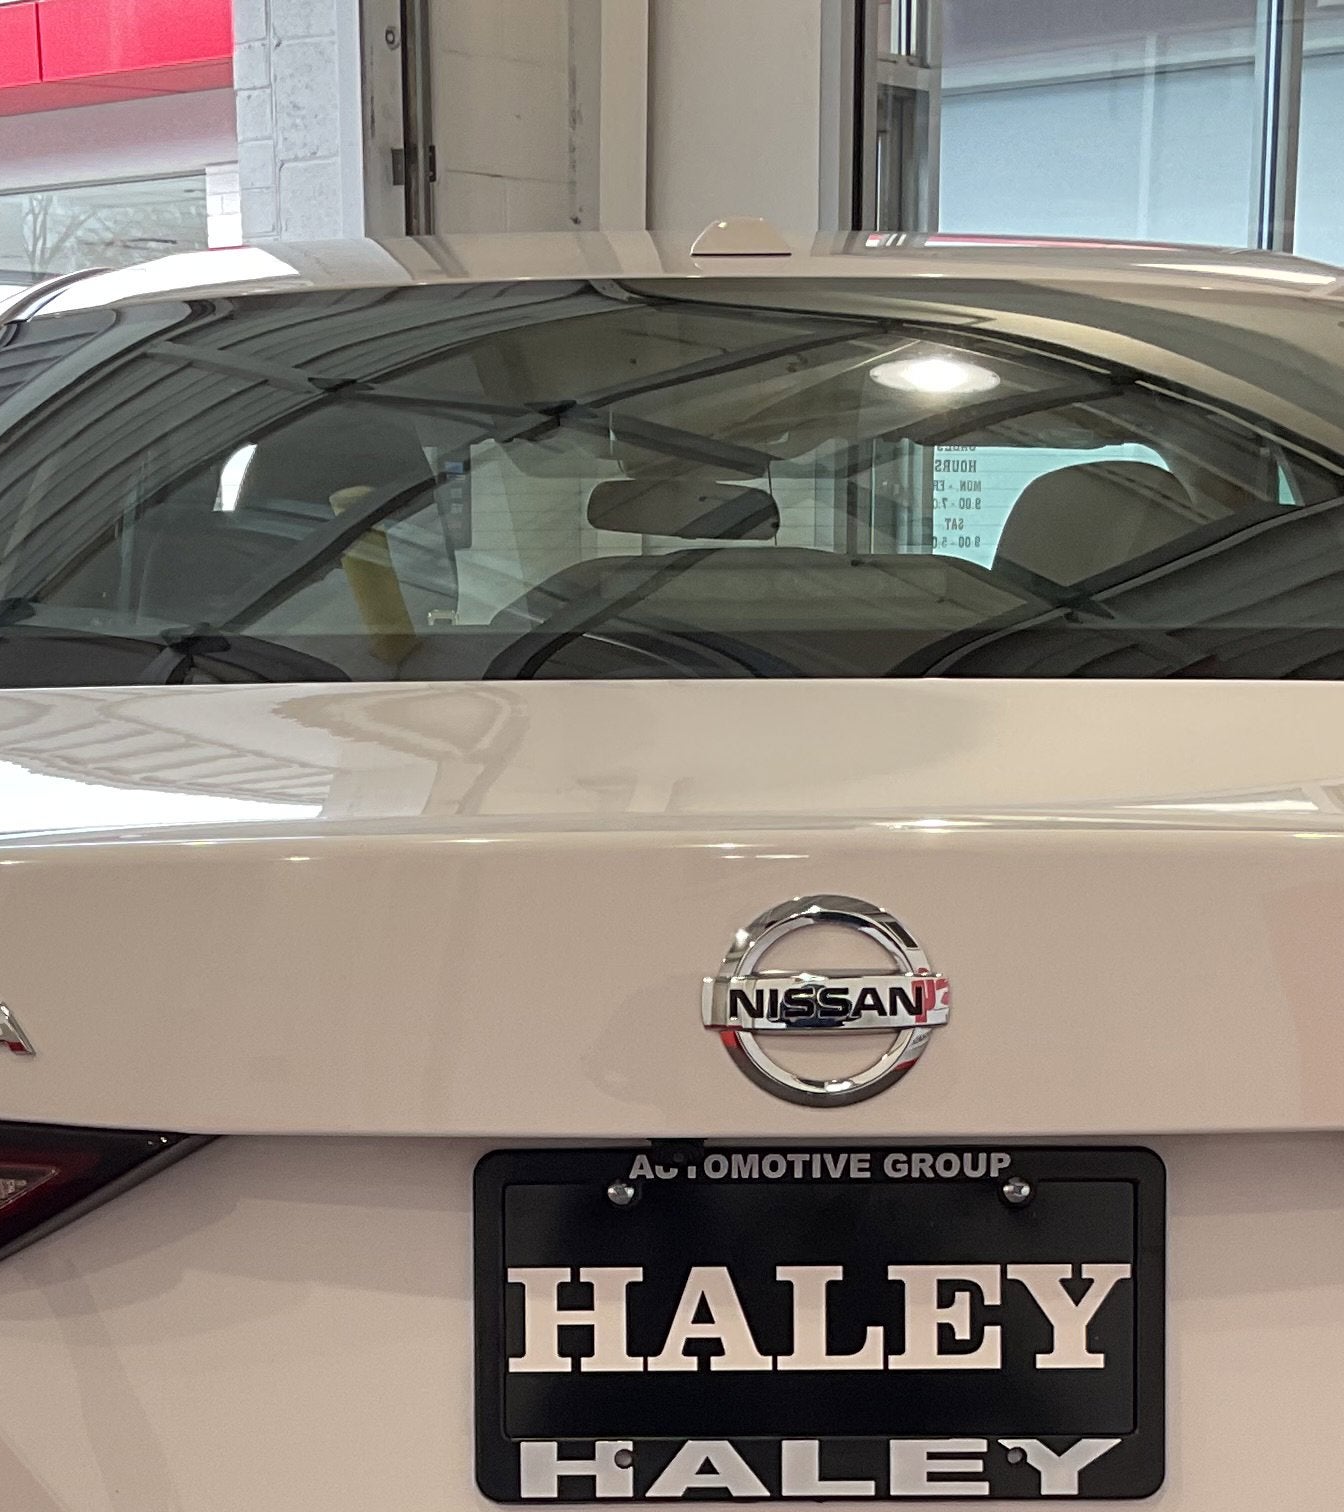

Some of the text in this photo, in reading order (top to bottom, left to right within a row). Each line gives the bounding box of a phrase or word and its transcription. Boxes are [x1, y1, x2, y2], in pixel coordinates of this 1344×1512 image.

[728, 986, 923, 1020] NISSAN
[883, 1152, 1011, 1179] GROUP
[507, 1263, 1132, 1373] HALEY
[519, 1438, 1123, 1499] HALEY
